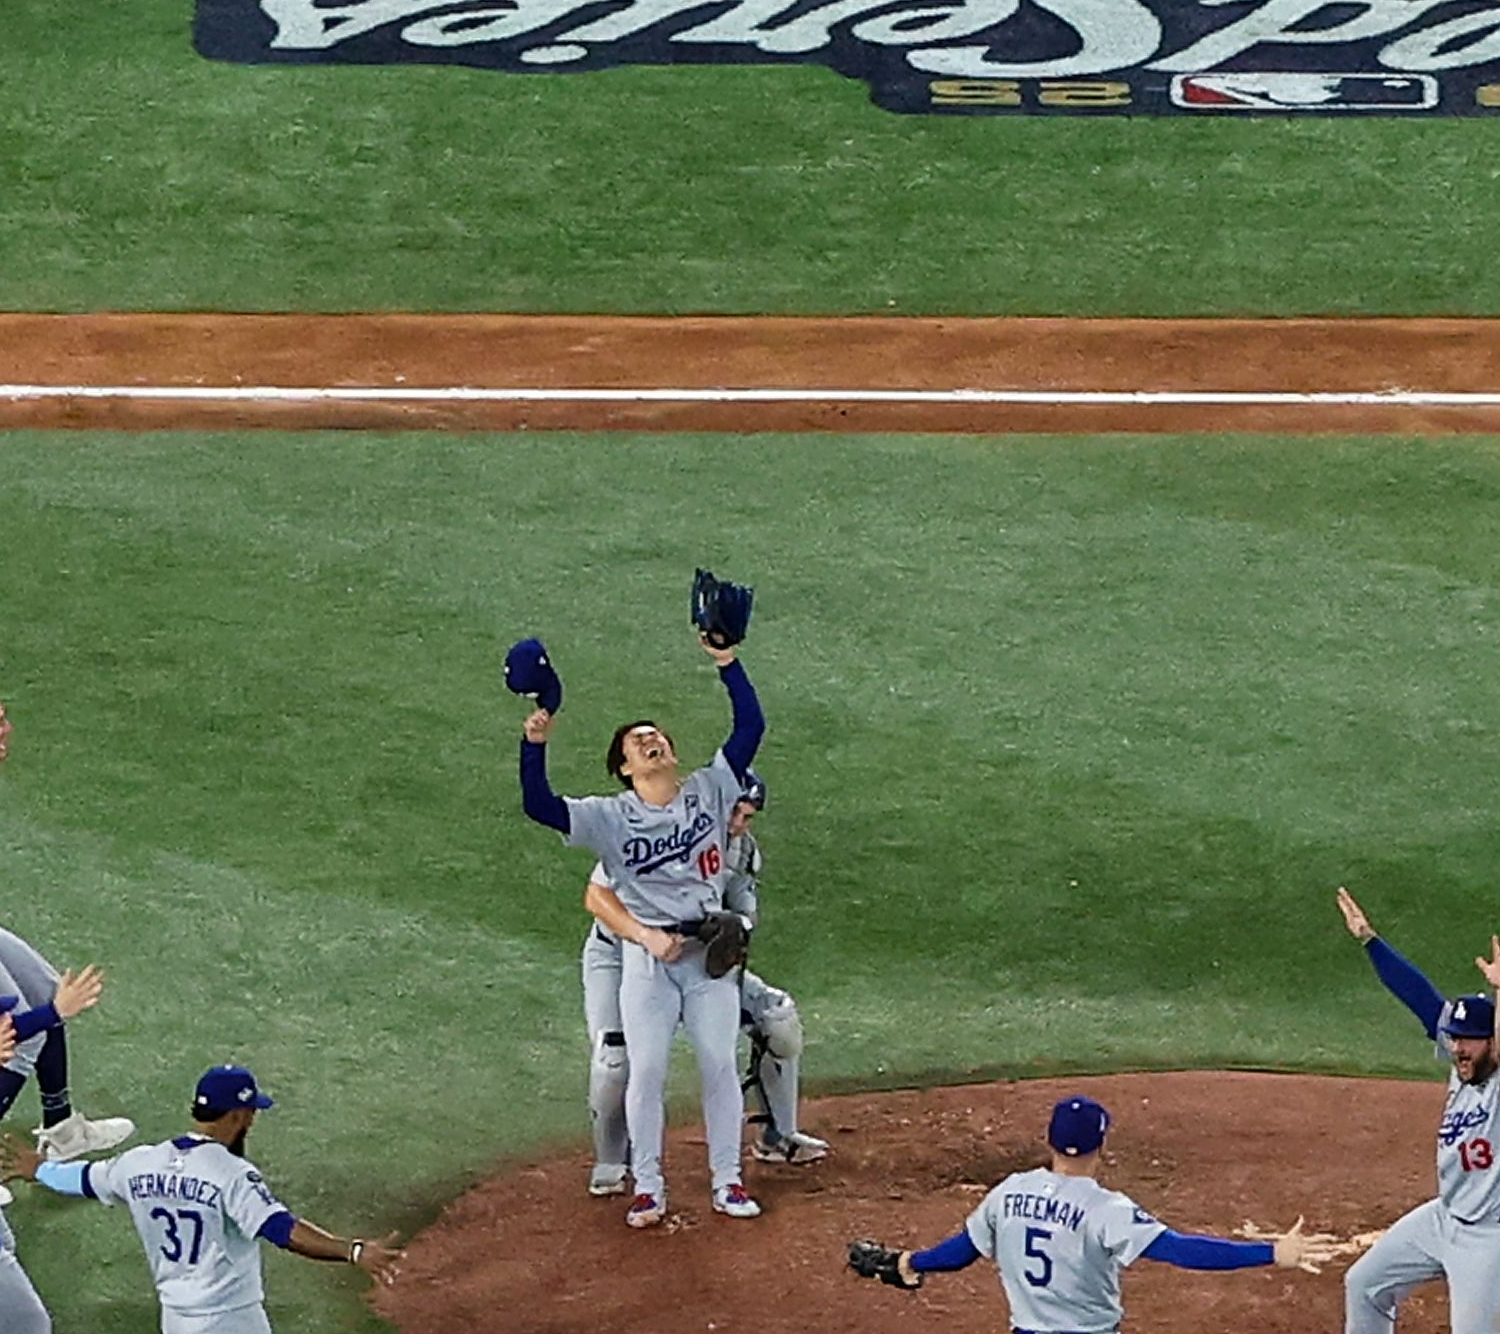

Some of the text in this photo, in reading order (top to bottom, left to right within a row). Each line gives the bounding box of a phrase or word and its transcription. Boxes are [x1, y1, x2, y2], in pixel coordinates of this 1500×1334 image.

[697, 844, 721, 880] 16
[1458, 1137, 1494, 1172] 13
[1003, 1193, 1085, 1234] FREEMAN
[150, 1207, 203, 1265] 37
[1024, 1228, 1054, 1288] 5
